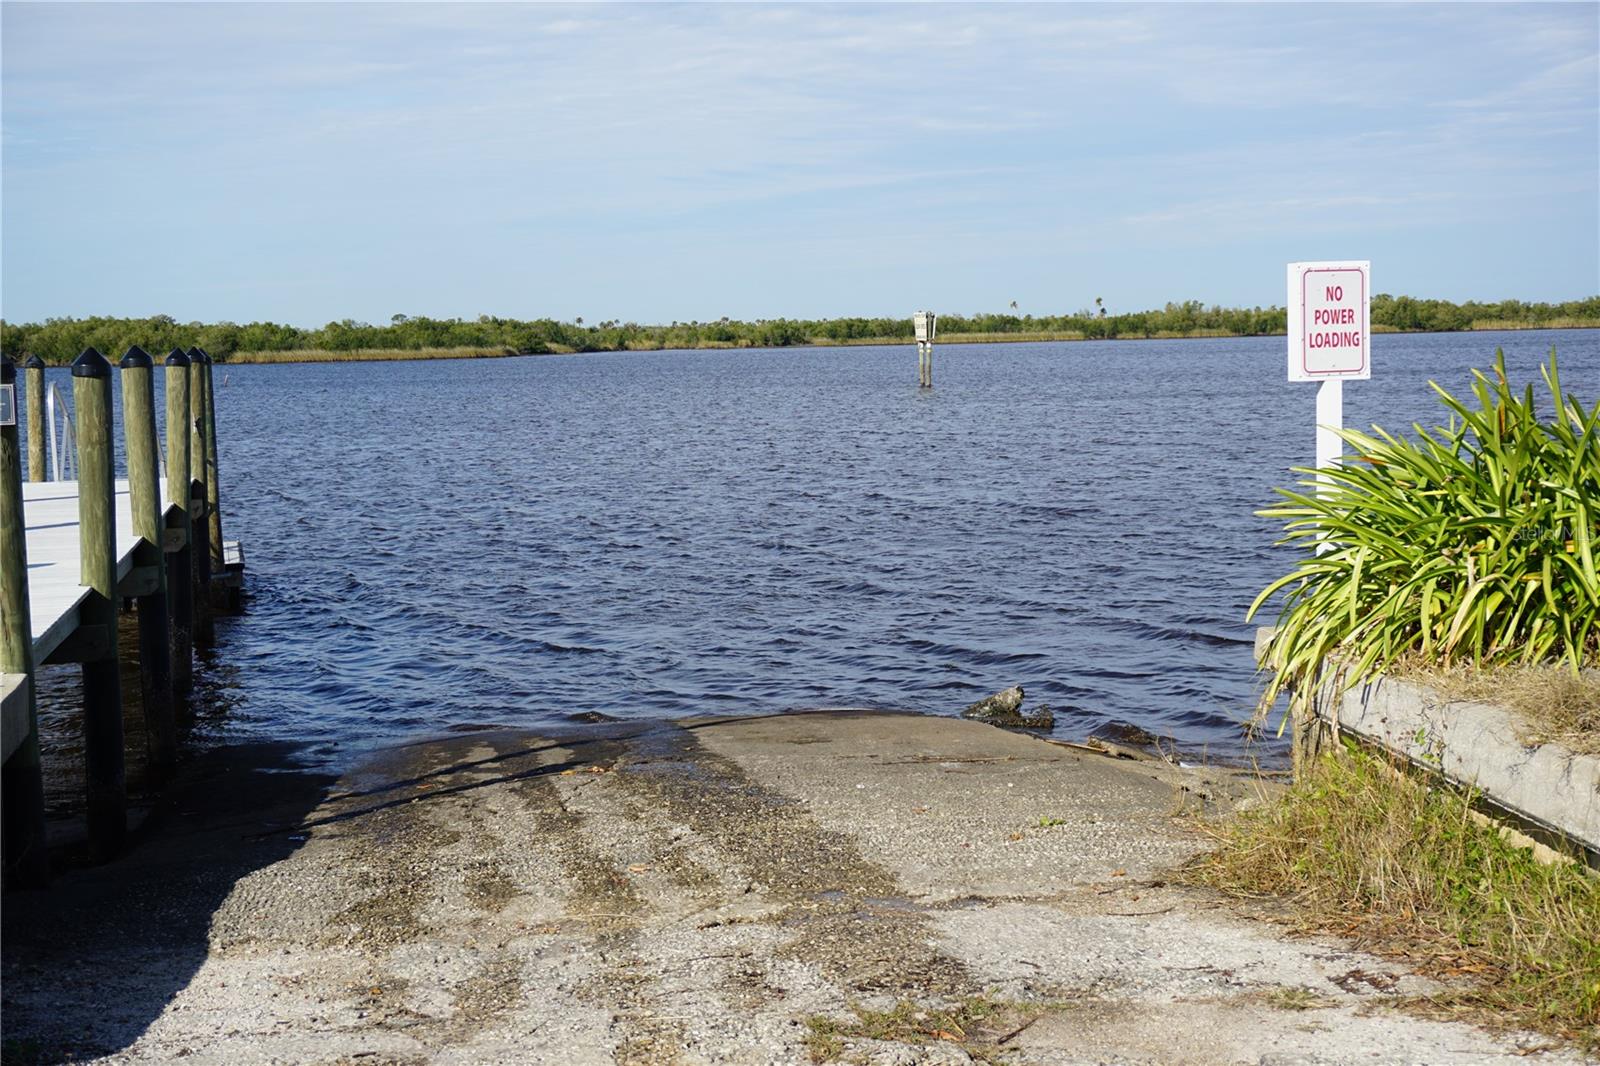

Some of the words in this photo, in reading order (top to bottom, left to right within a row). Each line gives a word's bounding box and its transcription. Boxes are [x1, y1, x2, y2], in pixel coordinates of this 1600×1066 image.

[1326, 286, 1343, 302] NO
[1314, 309, 1355, 325] POWER
[1309, 332, 1360, 348] LOADING
